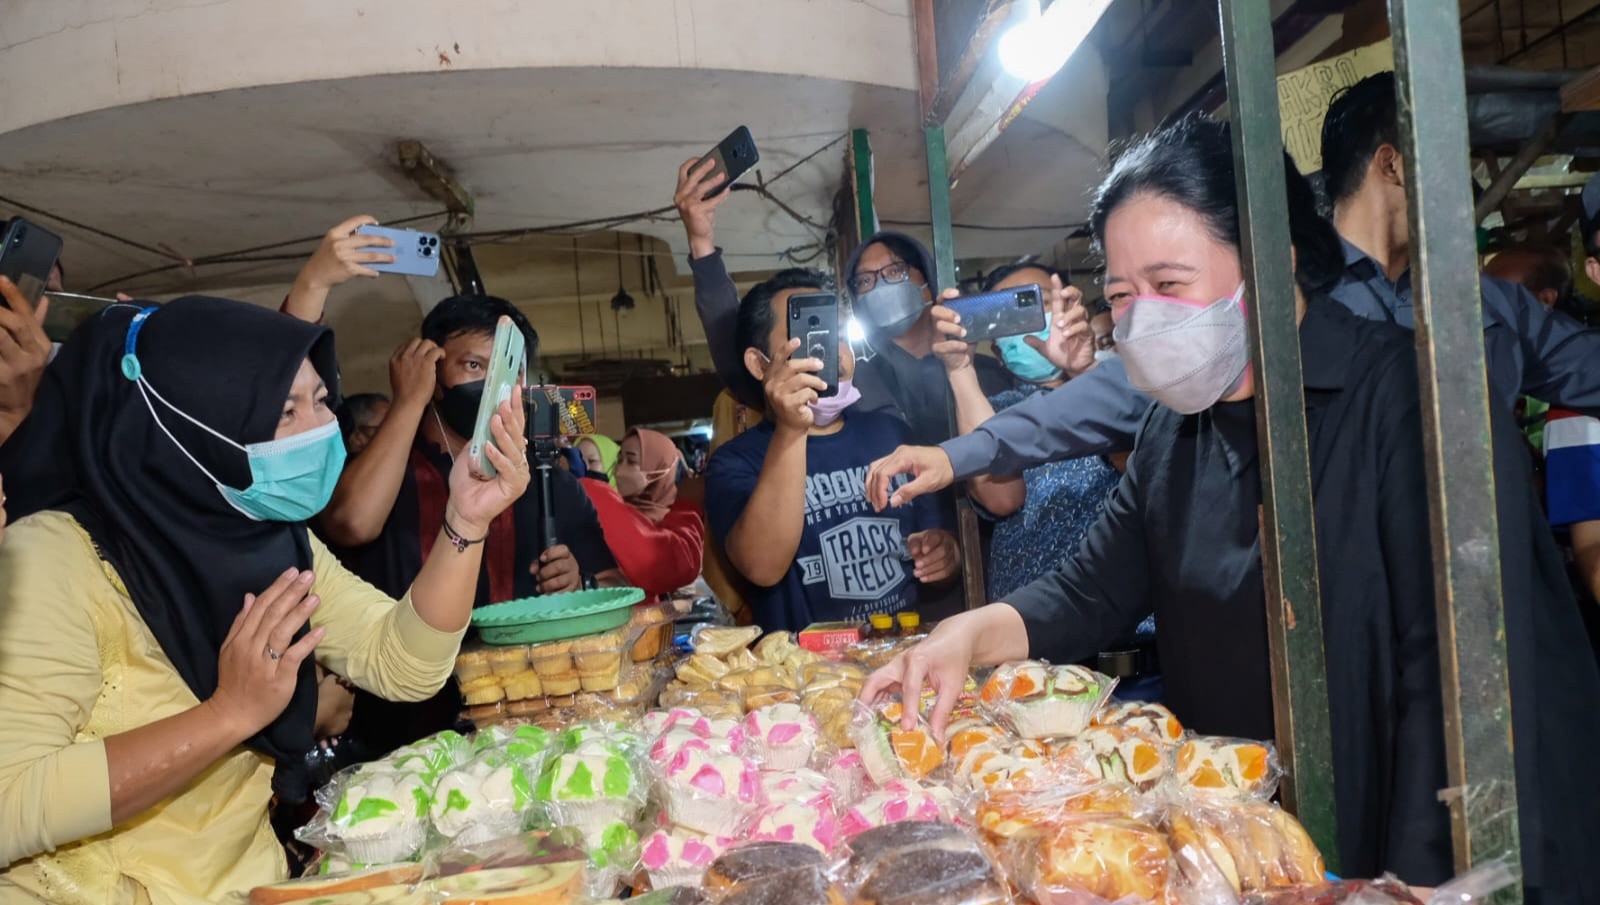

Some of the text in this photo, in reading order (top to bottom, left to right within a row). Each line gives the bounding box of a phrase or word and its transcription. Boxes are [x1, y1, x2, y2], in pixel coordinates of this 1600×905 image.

[804, 465, 908, 514] ROOK
[806, 502, 869, 525] NEW YORK
[826, 524, 899, 564] TRACK
[805, 560, 822, 577] 19
[841, 554, 896, 593] FIELD
